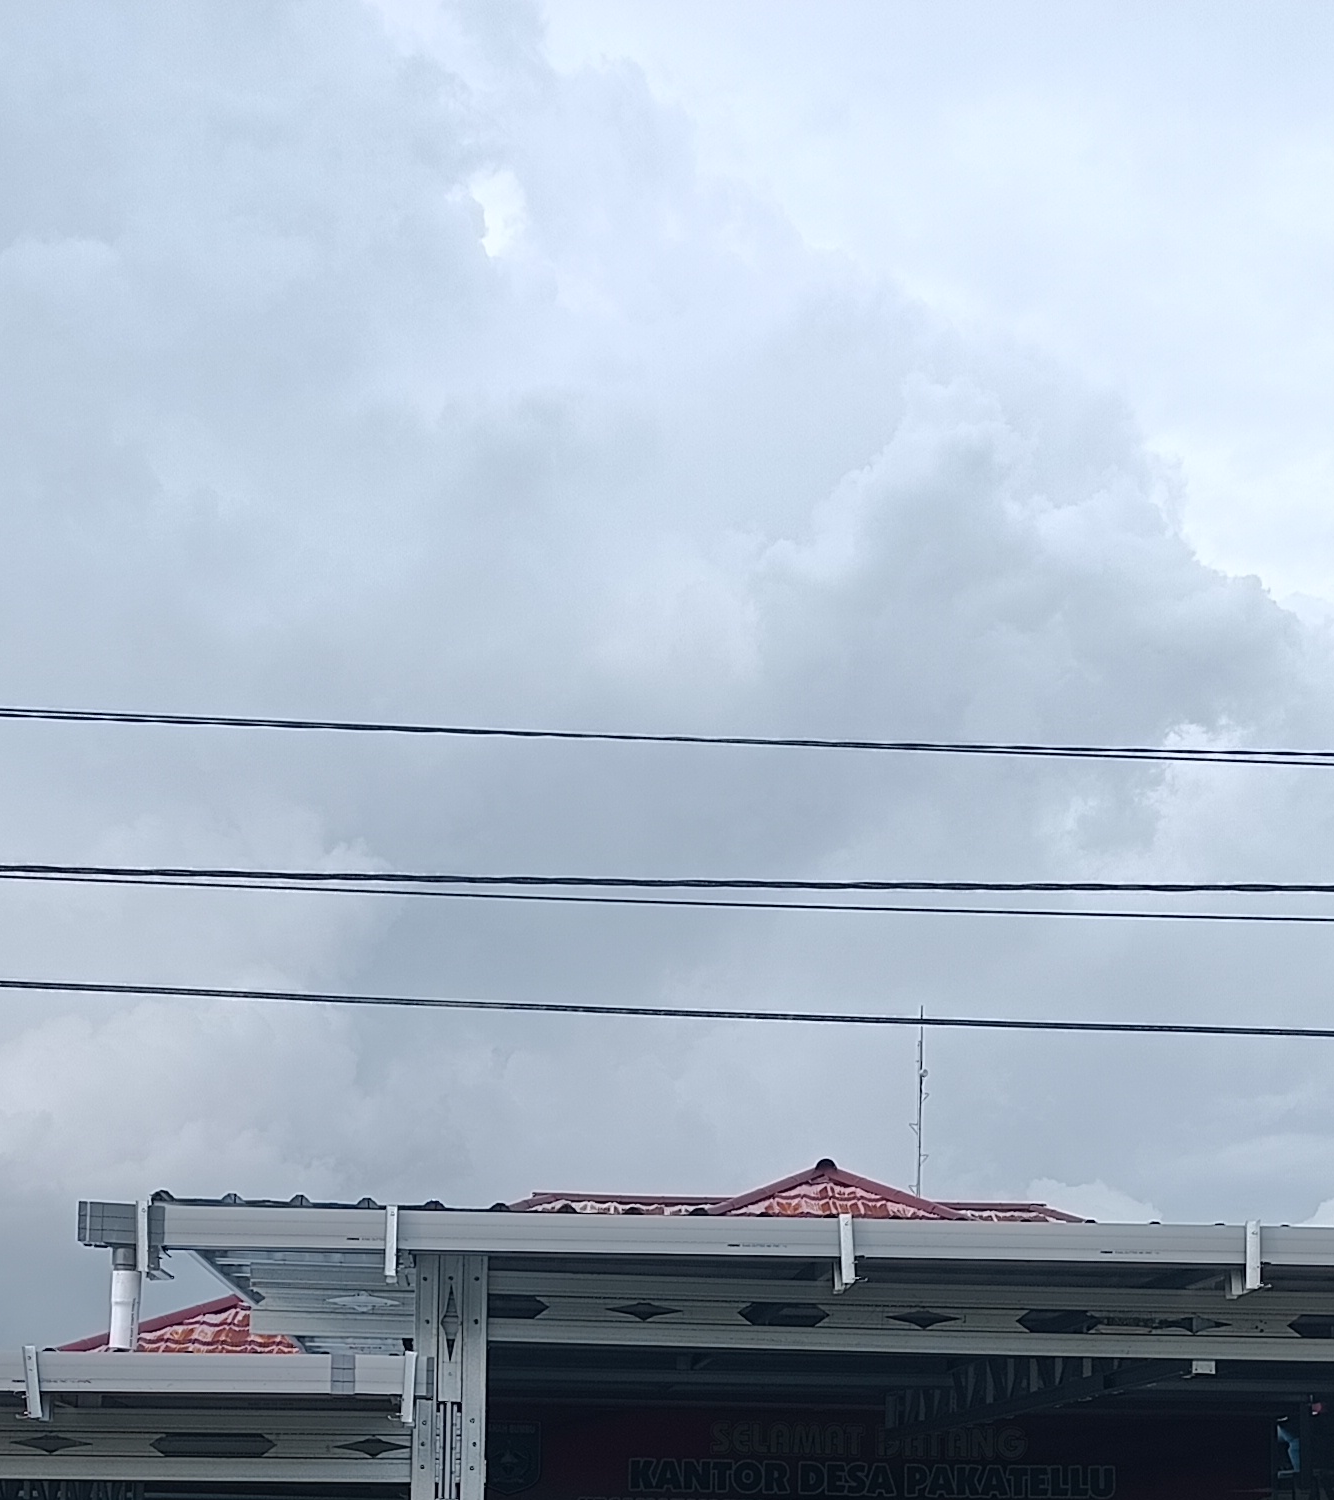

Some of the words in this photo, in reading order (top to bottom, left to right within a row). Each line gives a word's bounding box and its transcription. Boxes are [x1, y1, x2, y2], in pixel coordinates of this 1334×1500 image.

[710, 1421, 864, 1459] SELAMAT
[628, 1458, 790, 1494] KANTOR
[798, 1461, 897, 1496] DESA
[904, 1463, 1117, 1499] PAKATELLU
